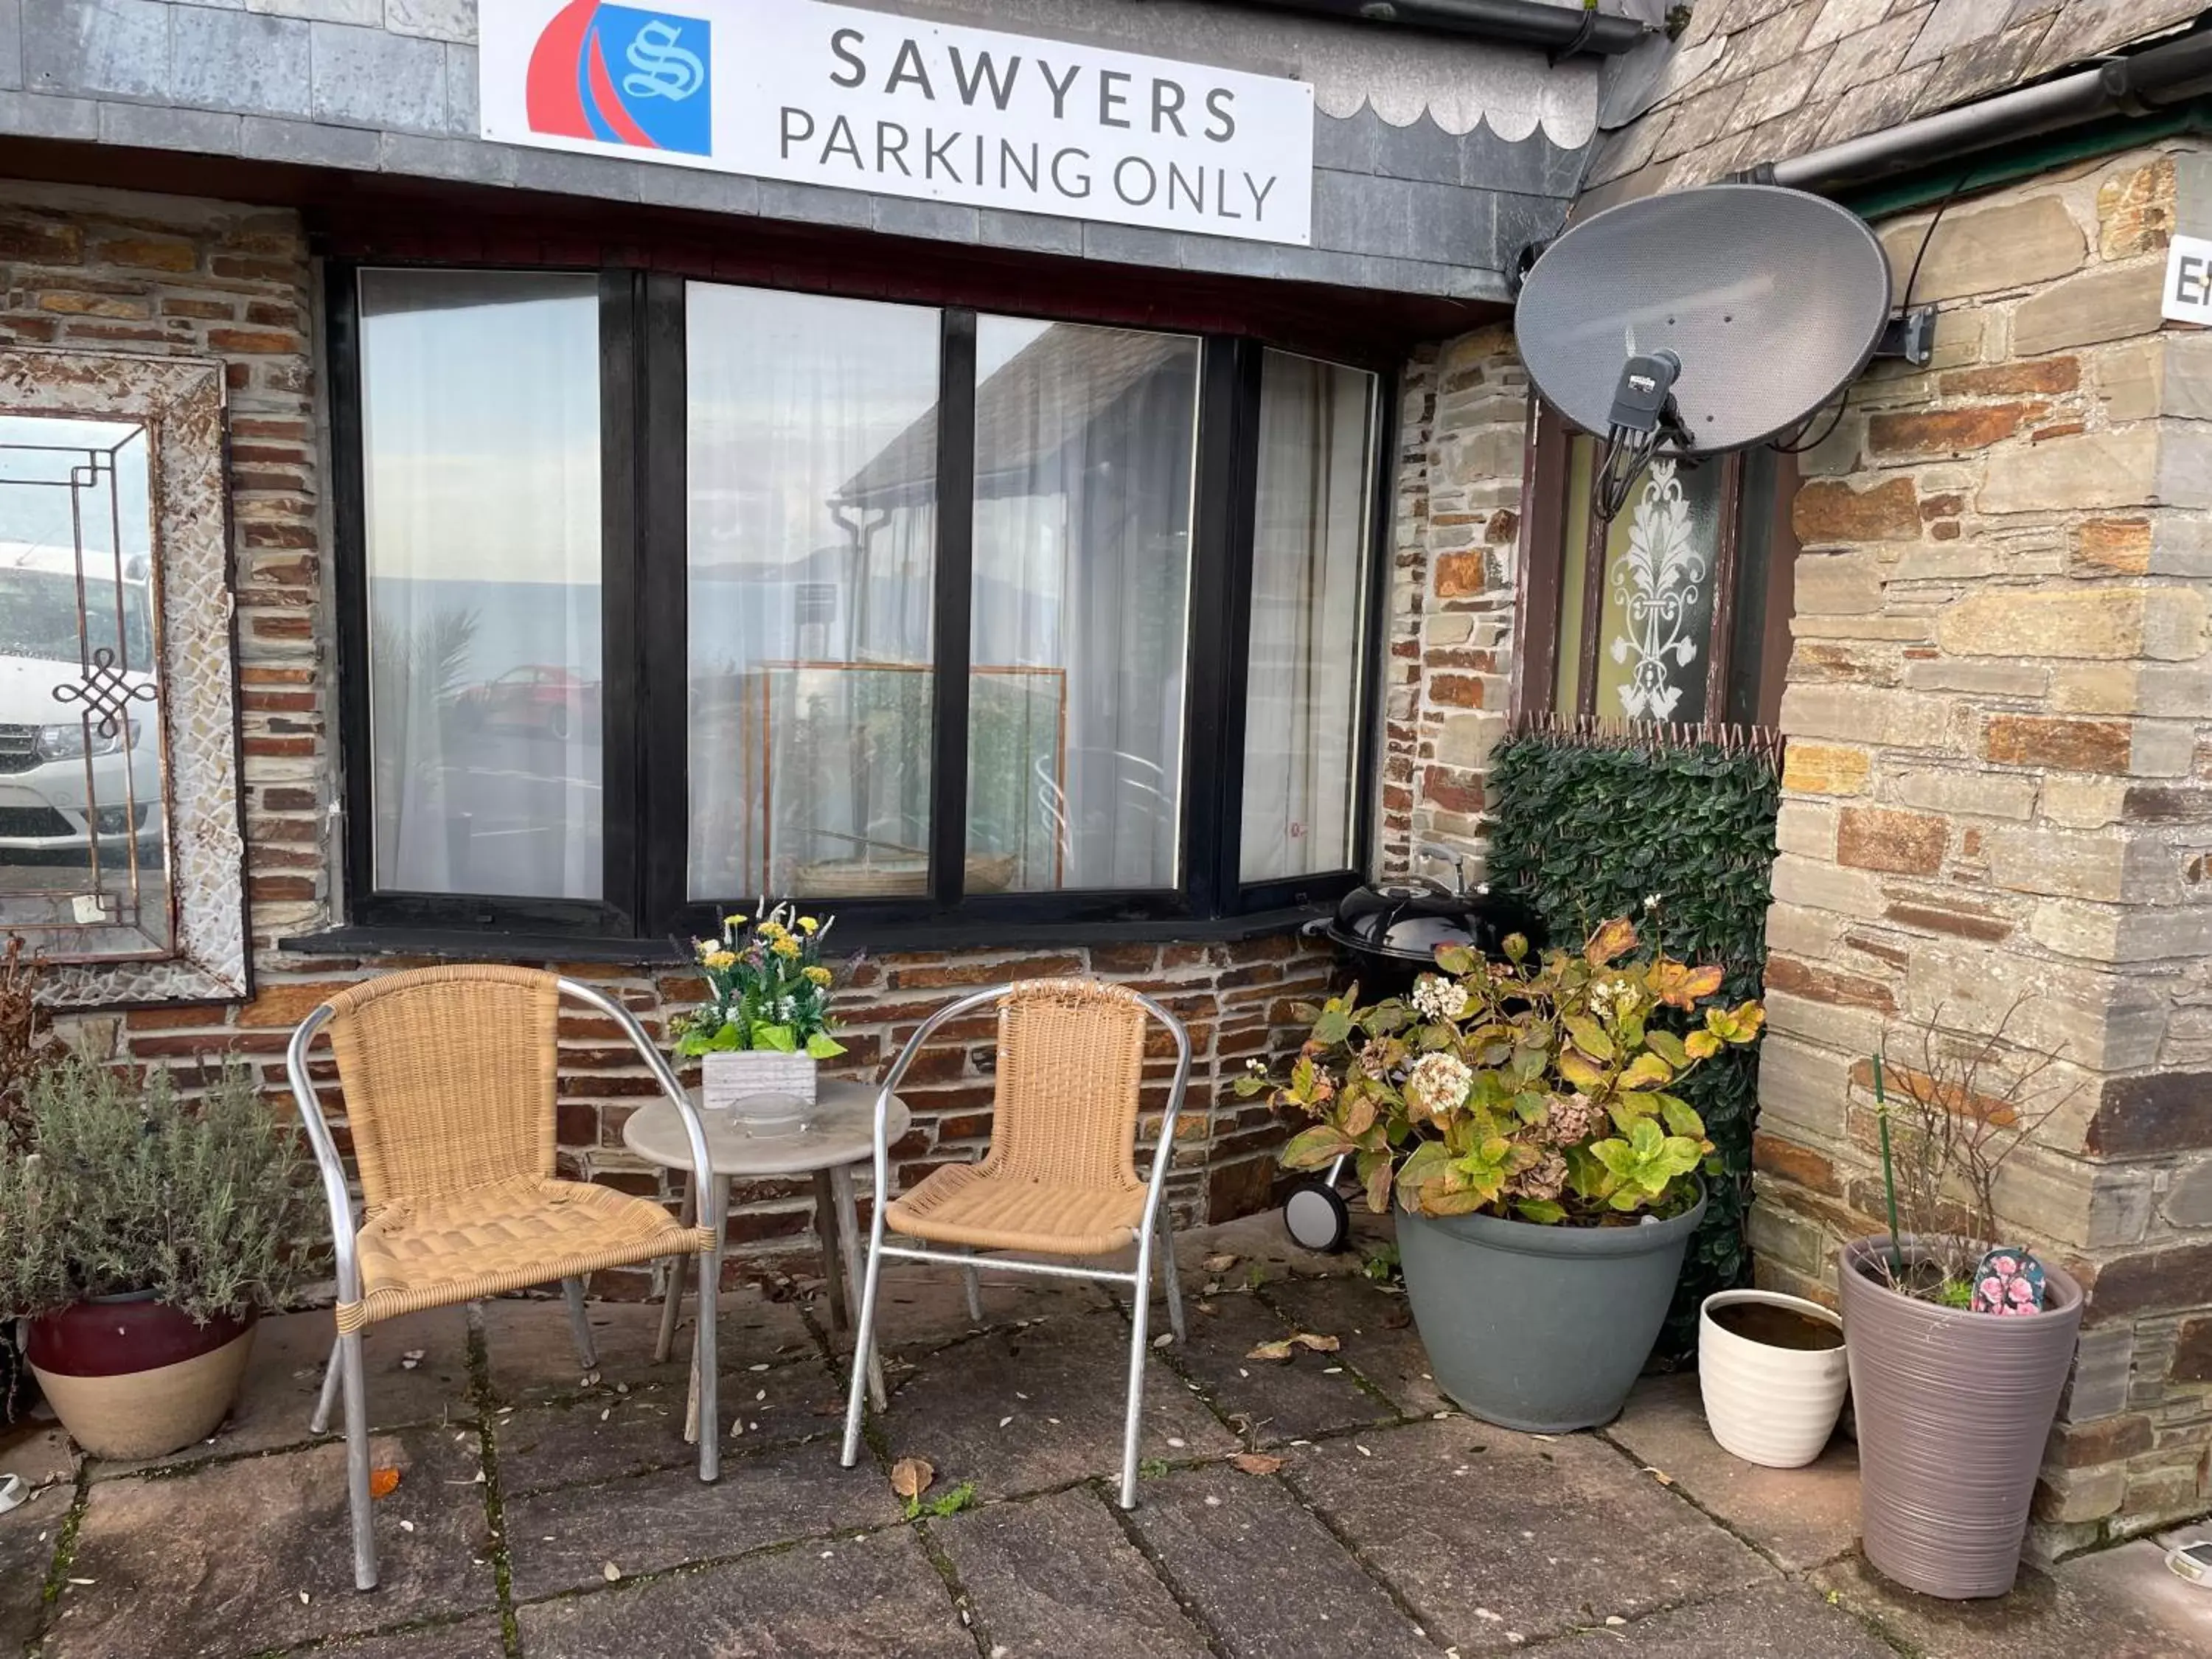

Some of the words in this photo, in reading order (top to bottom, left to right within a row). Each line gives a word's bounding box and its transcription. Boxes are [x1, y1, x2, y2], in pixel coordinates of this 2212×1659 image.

[830, 28, 1235, 143] SAWYERS
[781, 106, 1091, 198] PARKING
[1113, 156, 1276, 221] ONLY
